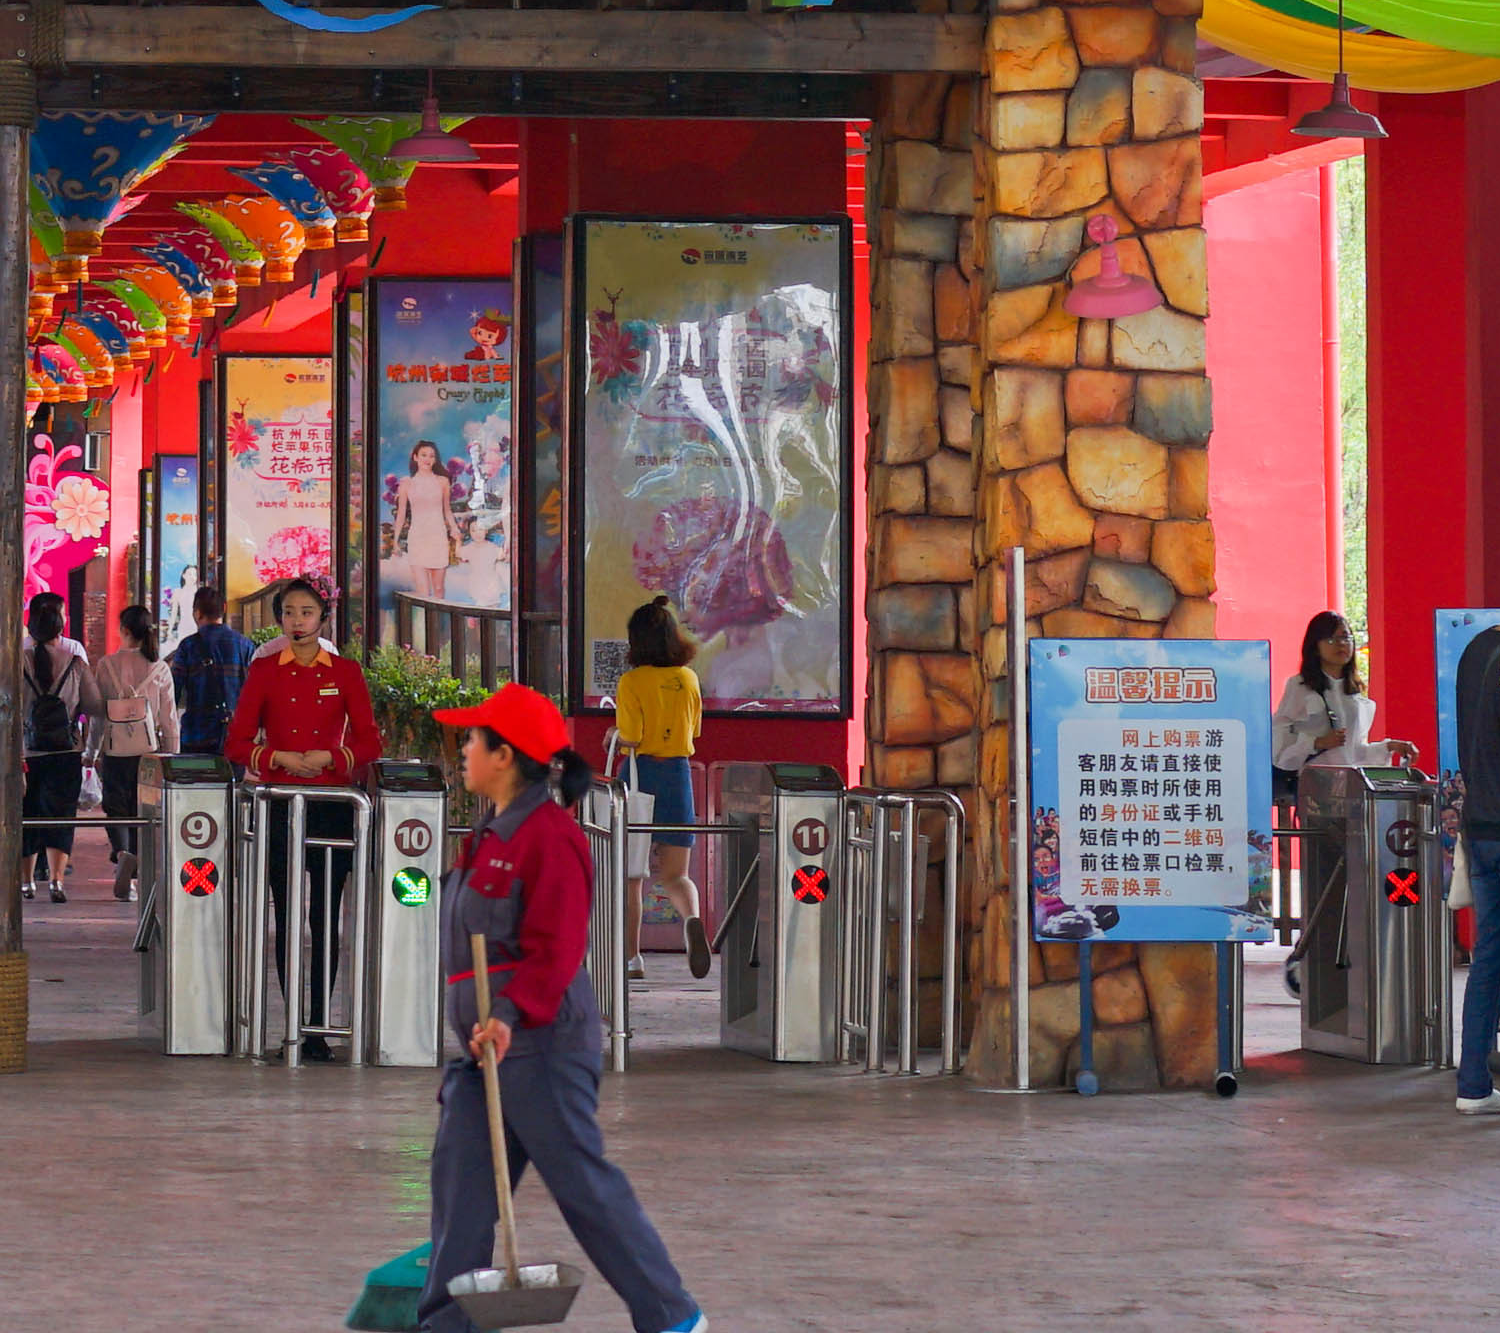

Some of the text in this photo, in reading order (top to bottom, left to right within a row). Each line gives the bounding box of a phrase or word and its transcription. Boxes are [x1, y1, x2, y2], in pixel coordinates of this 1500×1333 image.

[1086, 667, 1217, 703] 温馨提示
[1121, 728, 1225, 749] 网上购票游
[1077, 753, 1223, 773] 客朋友请直接使
[1078, 778, 1222, 798] 用购票时所使用
[1078, 803, 1225, 823] 的身份证或手机
[185, 814, 212, 846] 9
[397, 825, 430, 854] 10
[796, 824, 825, 849] 11
[1079, 828, 1225, 848] 短信中的二维码
[1079, 852, 1235, 874] 前往检票口检票，
[1080, 877, 1173, 897] 无需换票。
